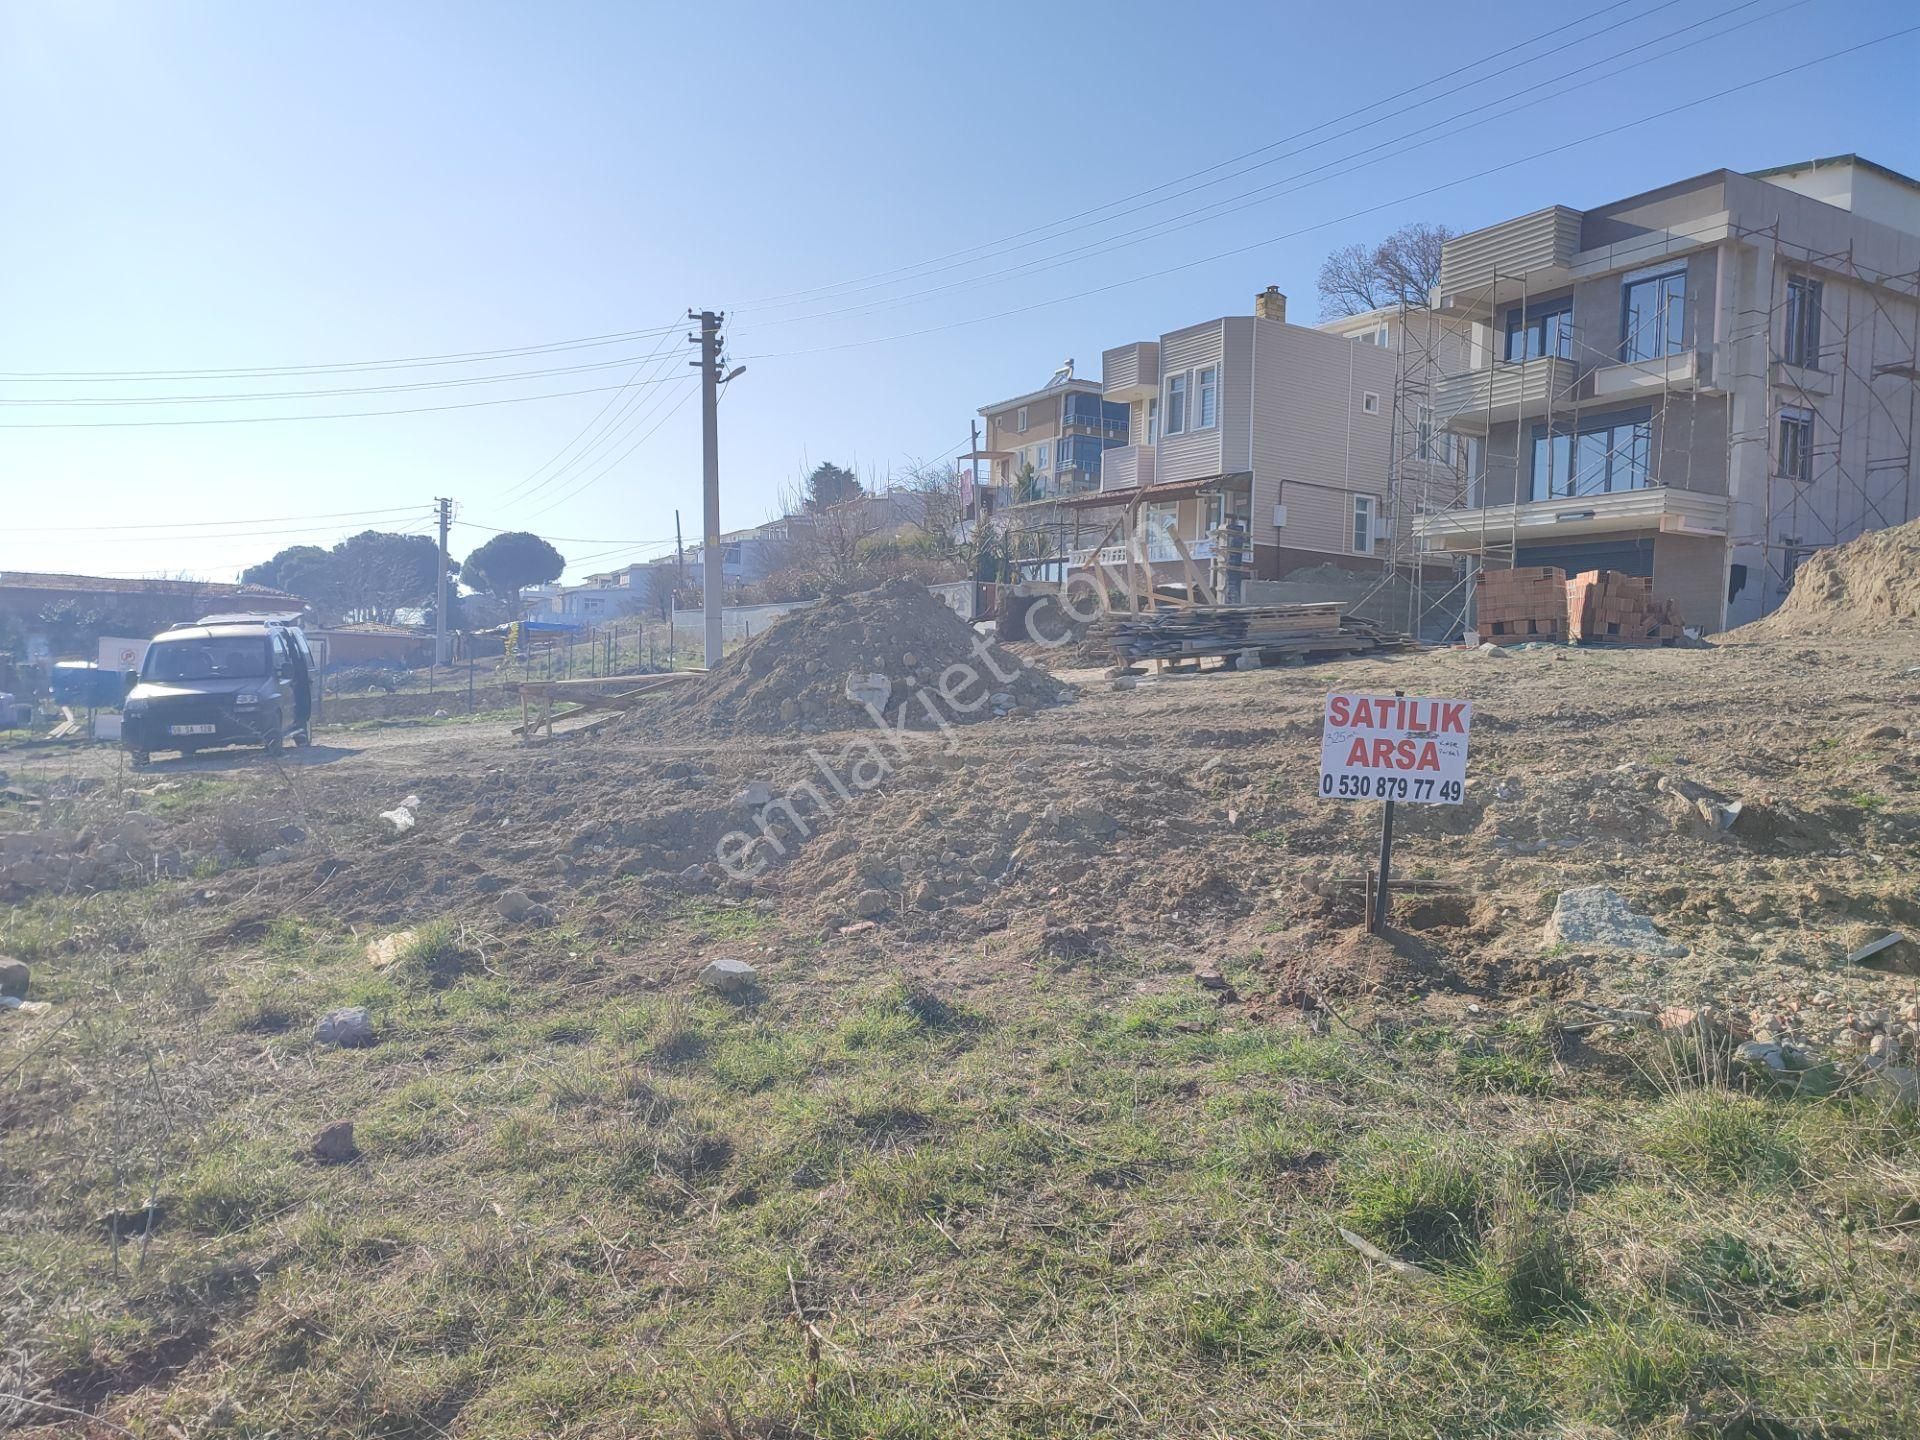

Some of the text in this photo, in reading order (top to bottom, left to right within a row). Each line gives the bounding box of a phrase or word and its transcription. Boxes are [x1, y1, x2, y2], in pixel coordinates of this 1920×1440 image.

[1328, 696, 1466, 734] SATILIK
[1346, 737, 1441, 772] ARSA
[1322, 773, 1461, 801] 0 530 879 77 49
